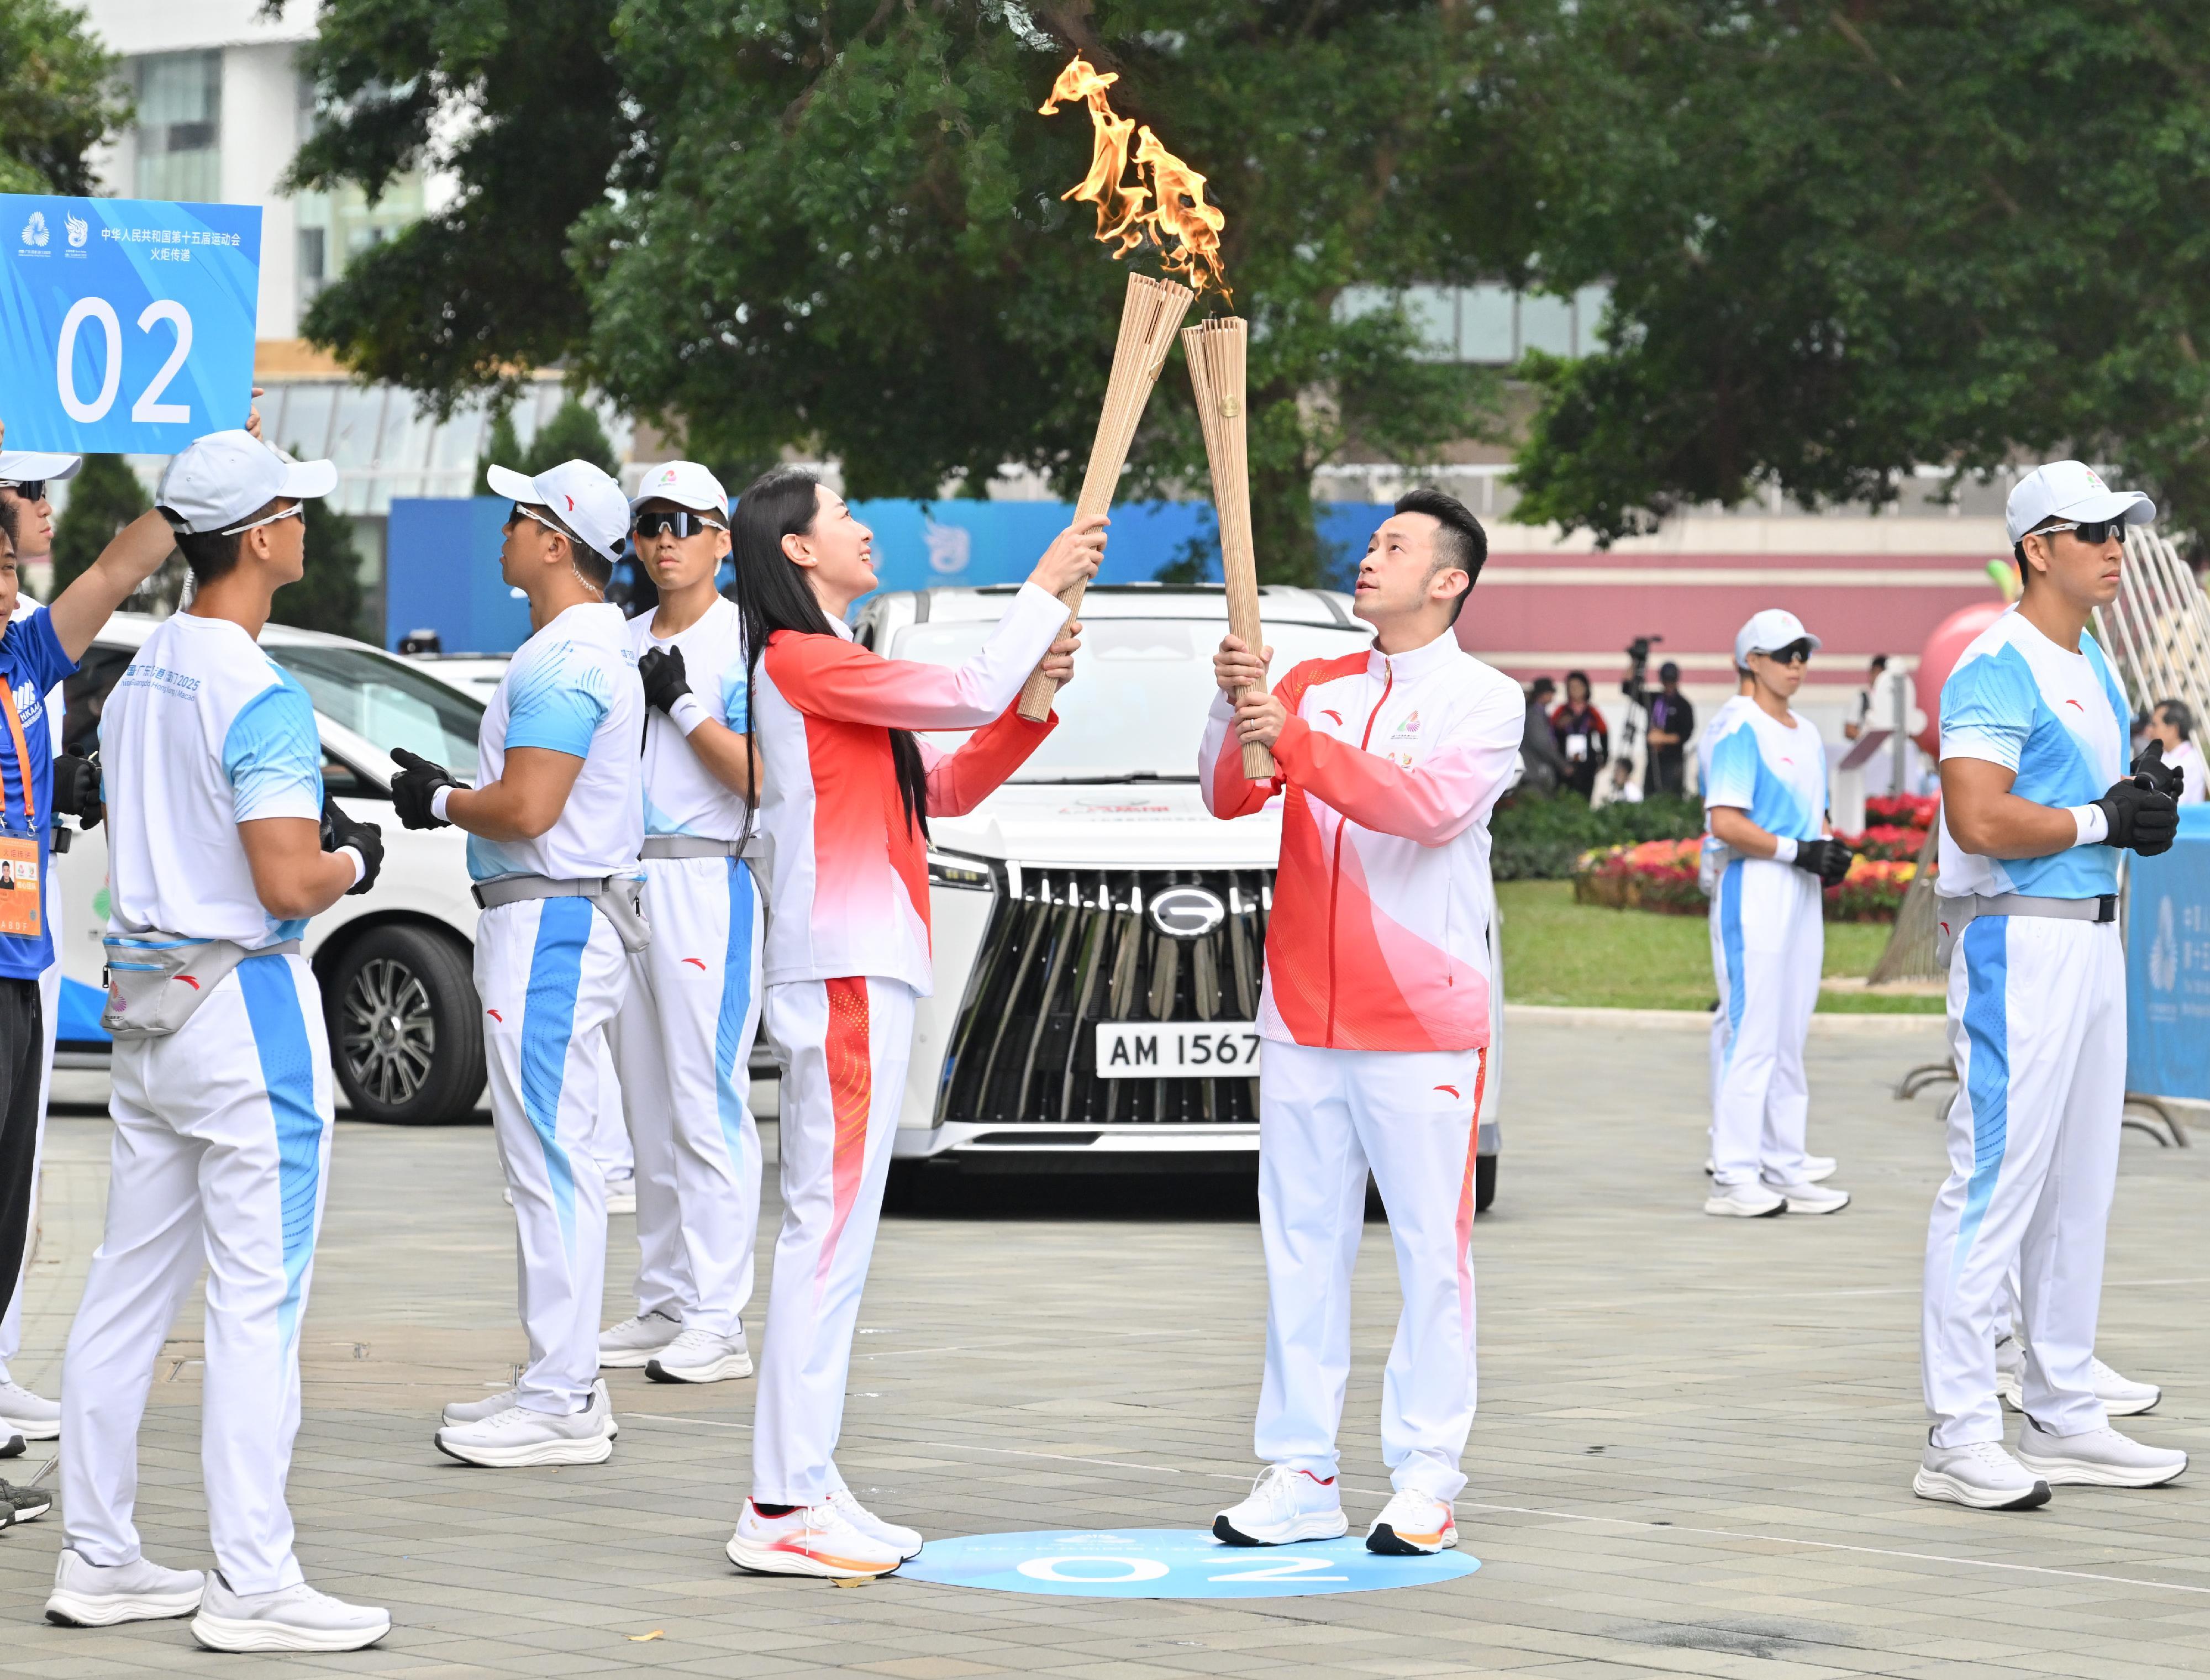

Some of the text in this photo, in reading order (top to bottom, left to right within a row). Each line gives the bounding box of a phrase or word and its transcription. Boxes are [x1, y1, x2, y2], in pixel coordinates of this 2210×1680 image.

[101, 227, 241, 246] 中华人民共和国第十五届运动会
[150, 247, 191, 262] 火炬传递
[57, 297, 193, 424] 02
[1110, 1034, 1261, 1065] AM 1567
[1016, 1556, 1350, 1582] 02
